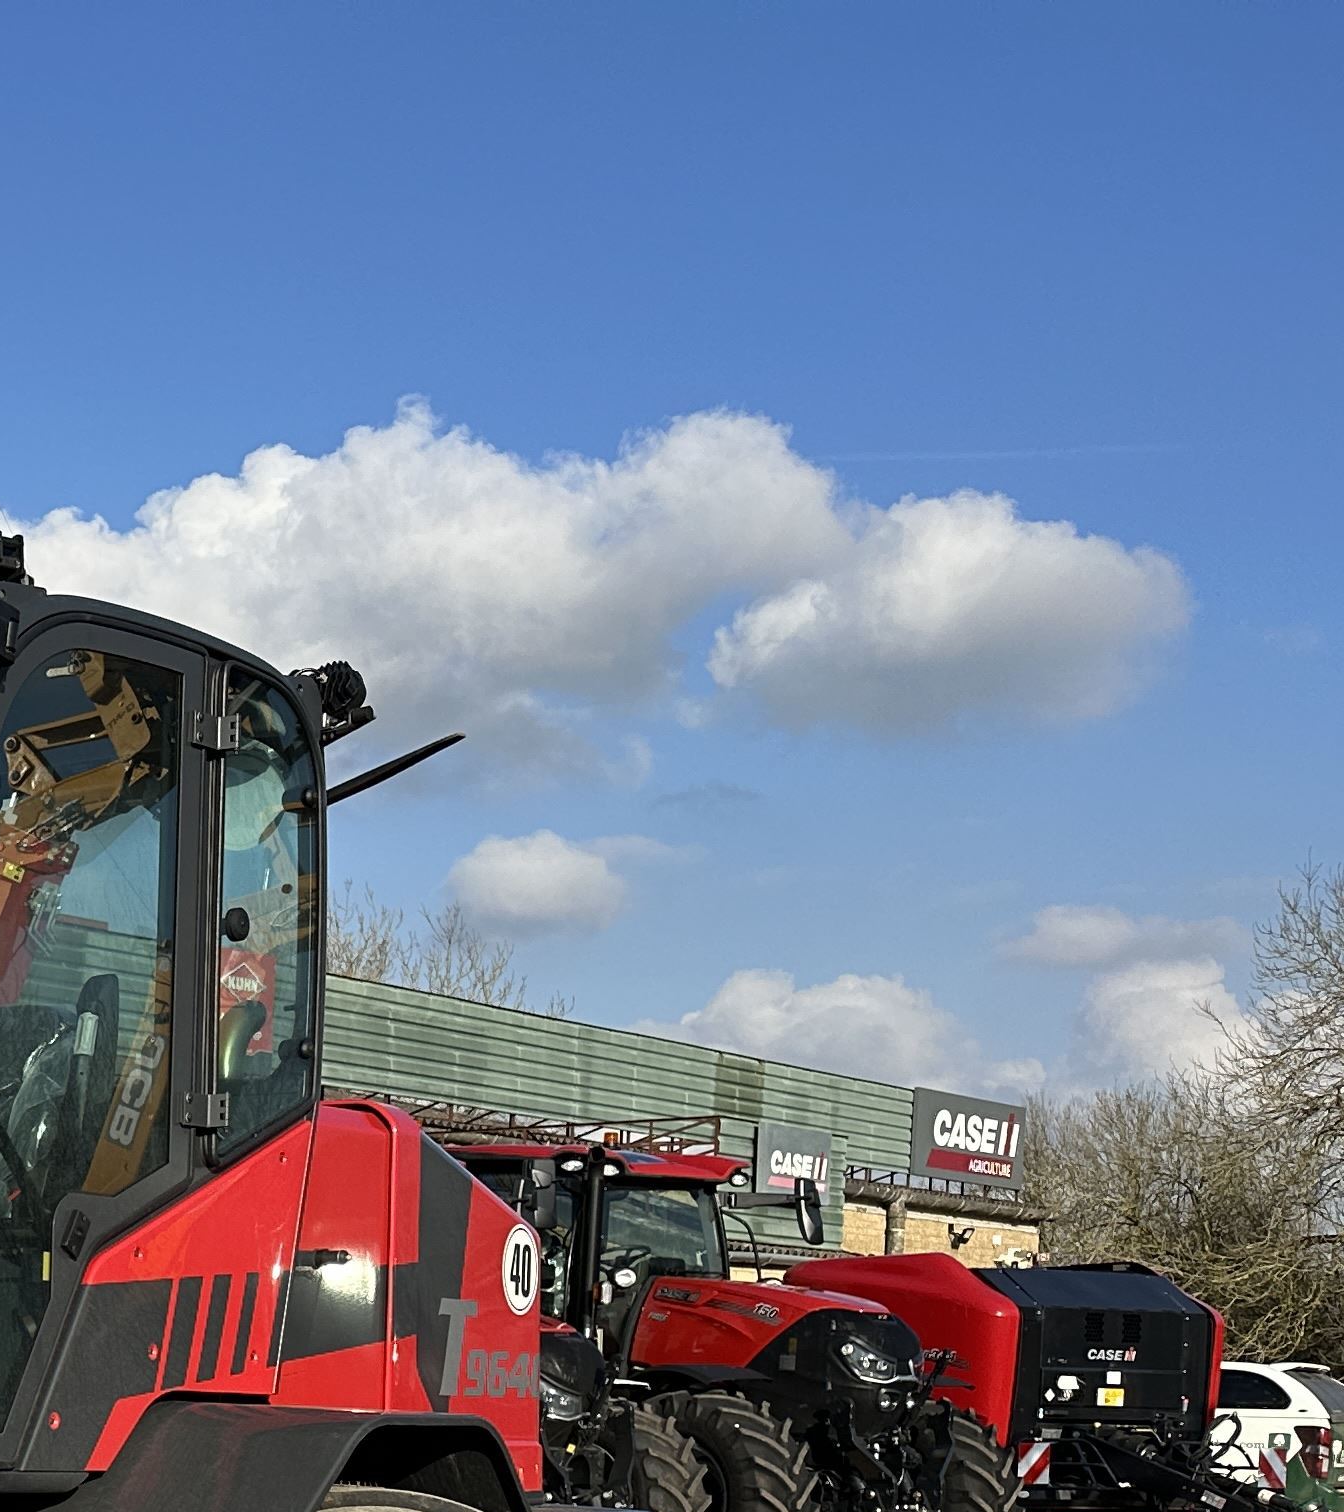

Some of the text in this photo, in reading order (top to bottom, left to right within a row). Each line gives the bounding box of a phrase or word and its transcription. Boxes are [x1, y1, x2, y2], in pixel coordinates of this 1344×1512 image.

[934, 1109, 998, 1154] CASE
[771, 1150, 813, 1179] CASE
[510, 1243, 532, 1298] 40
[1087, 1348, 1124, 1361] CASE
